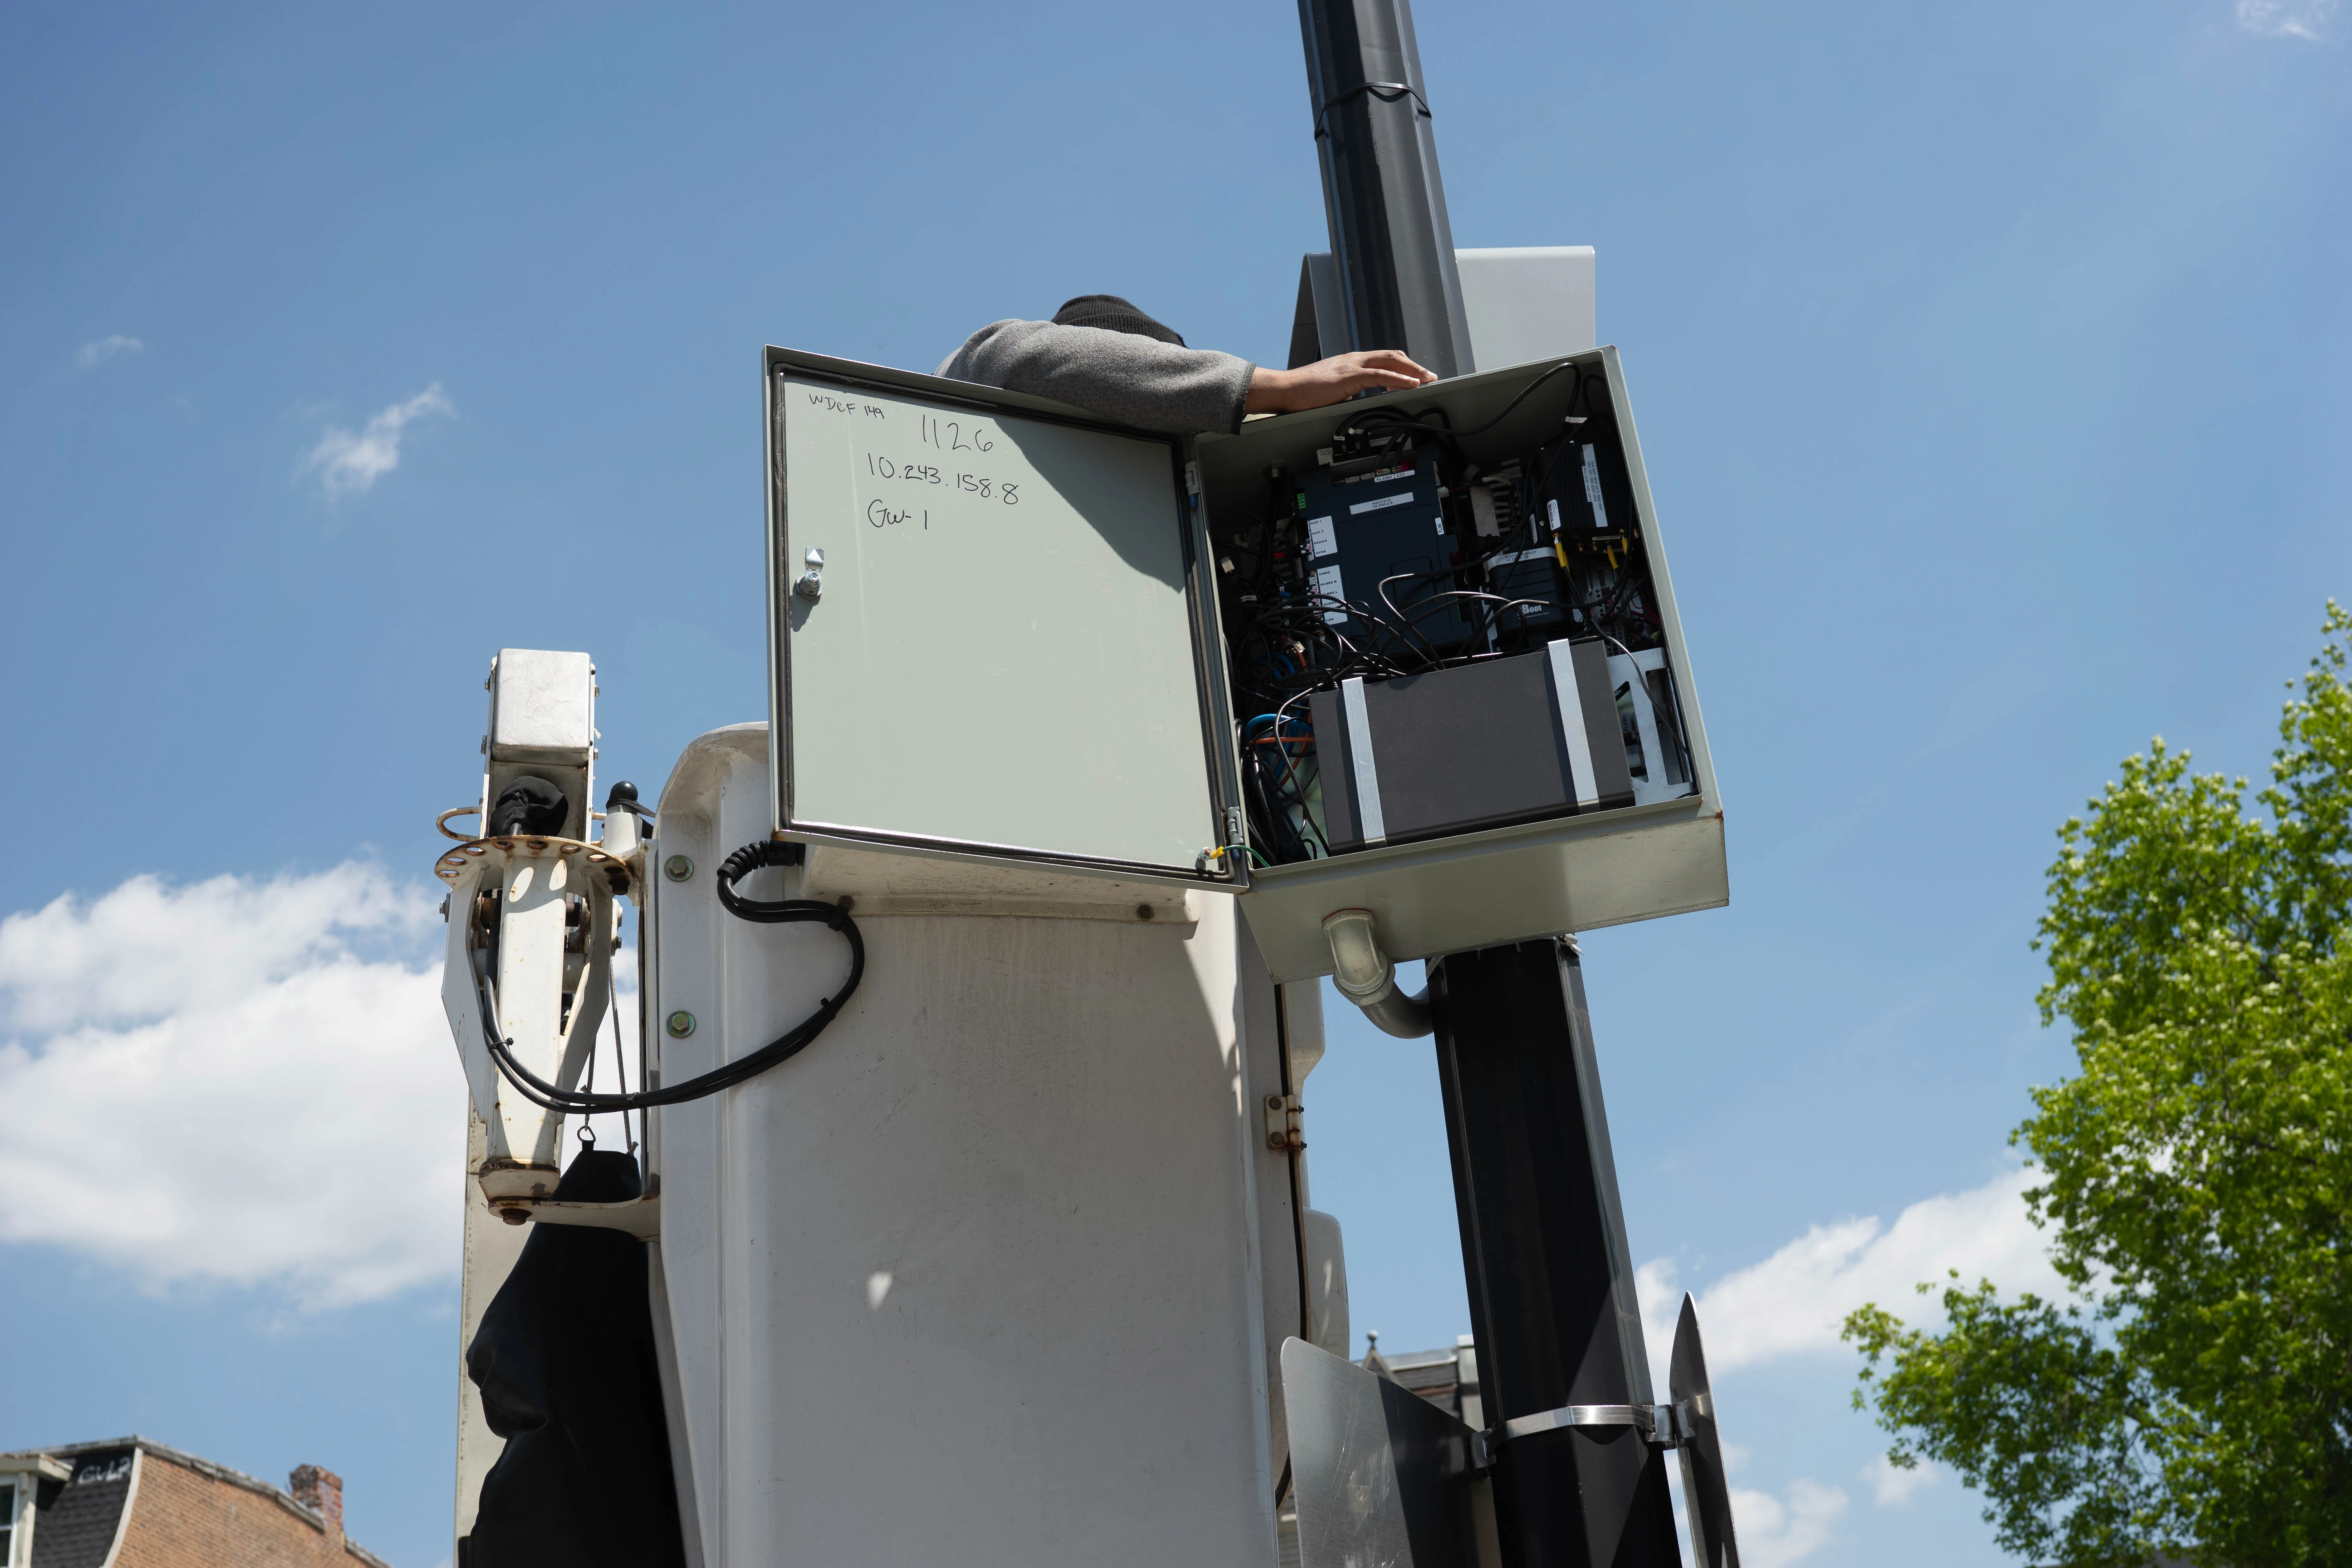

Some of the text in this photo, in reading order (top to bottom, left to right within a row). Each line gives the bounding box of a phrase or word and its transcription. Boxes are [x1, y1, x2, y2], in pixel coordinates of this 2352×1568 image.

[864, 405, 884, 419] 149
[923, 414, 993, 452] 1126
[868, 453, 1018, 505] 10.243.158.8
